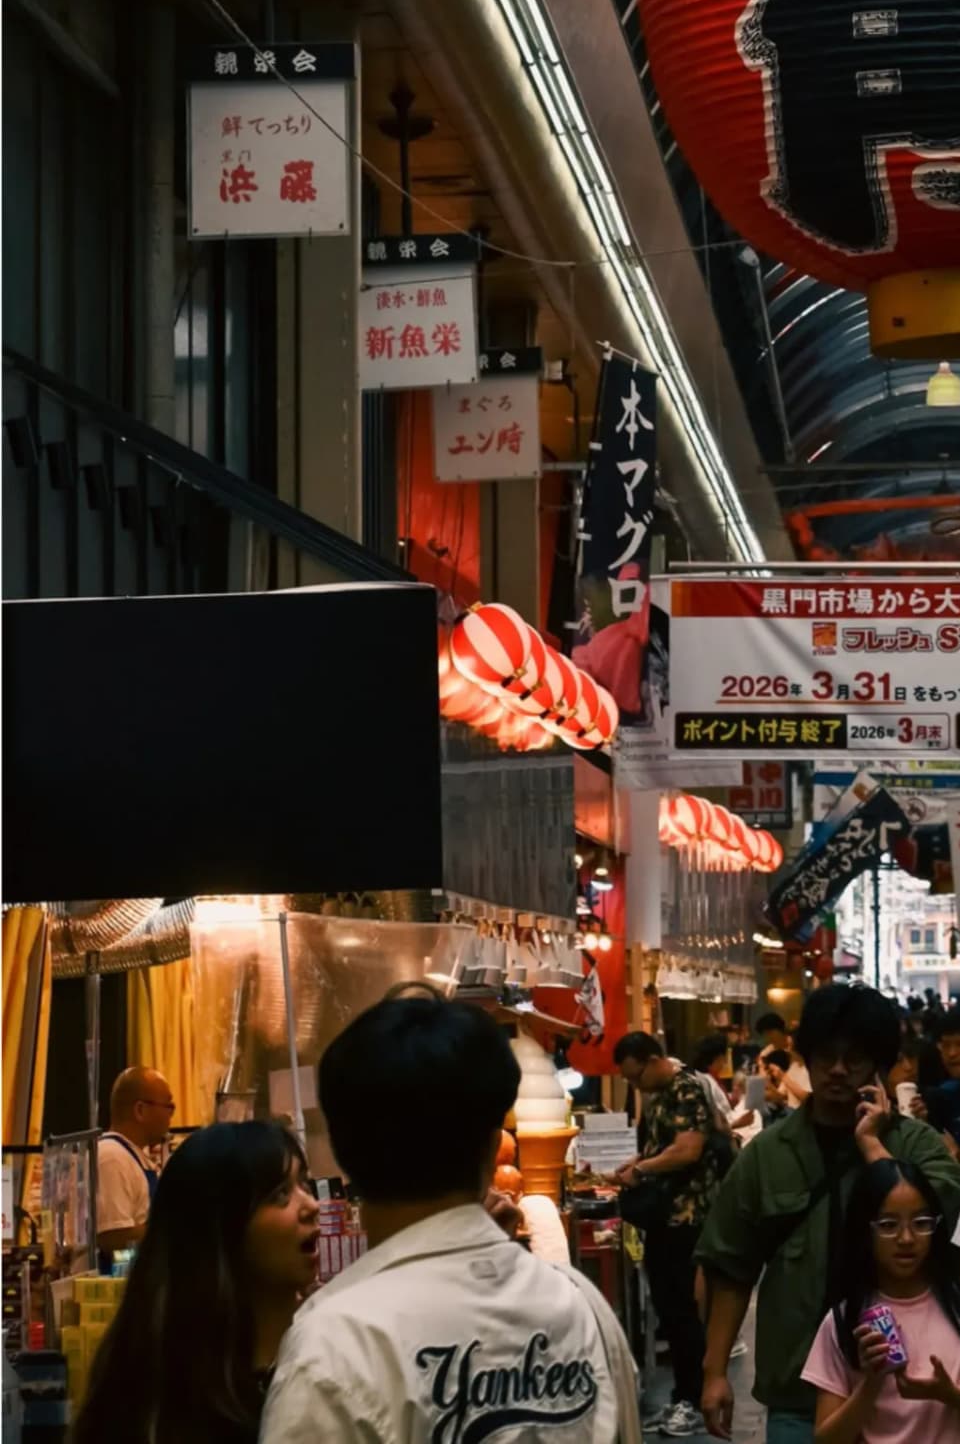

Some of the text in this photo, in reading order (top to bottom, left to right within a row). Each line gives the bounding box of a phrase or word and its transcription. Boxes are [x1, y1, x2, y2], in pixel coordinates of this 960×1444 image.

[220, 160, 317, 204] 浜藤
[366, 322, 462, 361] 新魚栄
[458, 395, 513, 414] まぐろ
[608, 379, 654, 617] 本マグロ
[683, 720, 841, 743] ポイント付与終了
[415, 1332, 598, 1444] Yankees
